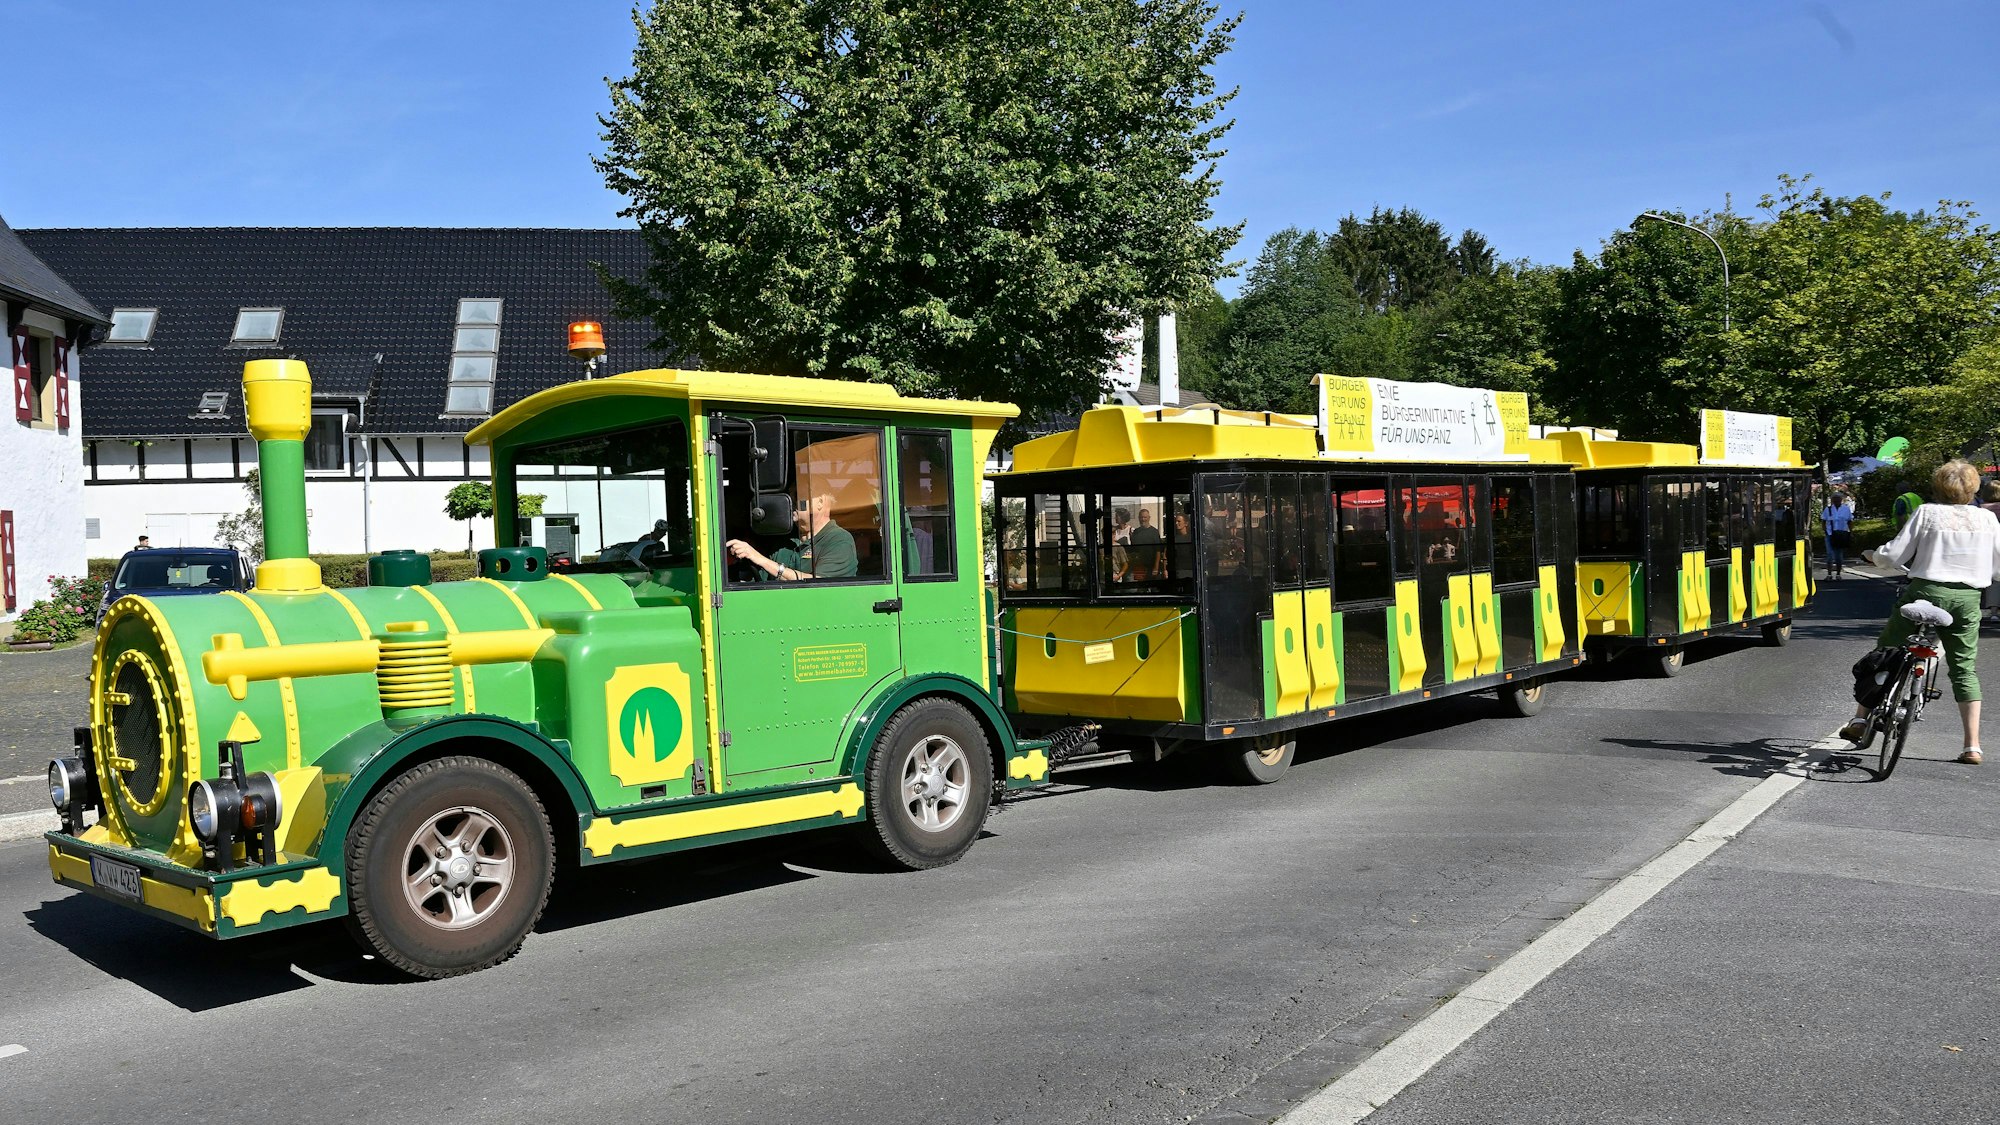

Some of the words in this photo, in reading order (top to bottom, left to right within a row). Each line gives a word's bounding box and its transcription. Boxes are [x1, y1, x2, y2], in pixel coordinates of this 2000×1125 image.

[1347, 397, 1366, 409] UNS
[1382, 403, 1466, 424] BÜRGERINITIATIVE
[1381, 424, 1402, 443] FÜR
[1405, 428, 1425, 443] UNS
[1427, 426, 1451, 444] PÄNZ
[120, 868, 137, 893] 423
